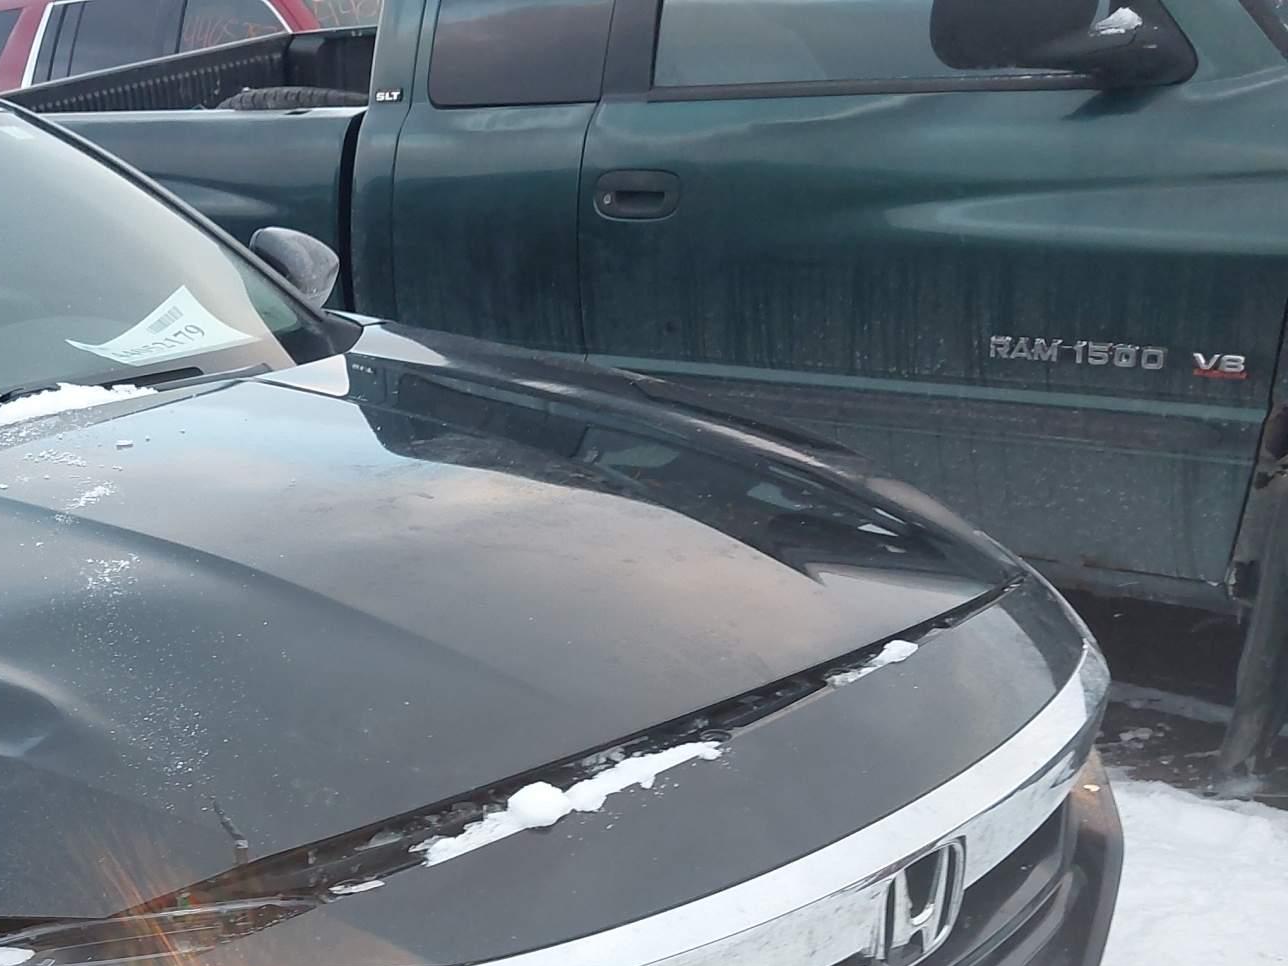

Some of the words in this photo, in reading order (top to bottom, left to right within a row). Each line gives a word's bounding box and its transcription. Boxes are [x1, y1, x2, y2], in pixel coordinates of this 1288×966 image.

[376, 91, 401, 102] SLT
[989, 335, 1062, 363] RAM
[1072, 340, 1166, 370] 1500
[1193, 352, 1246, 373] V8
